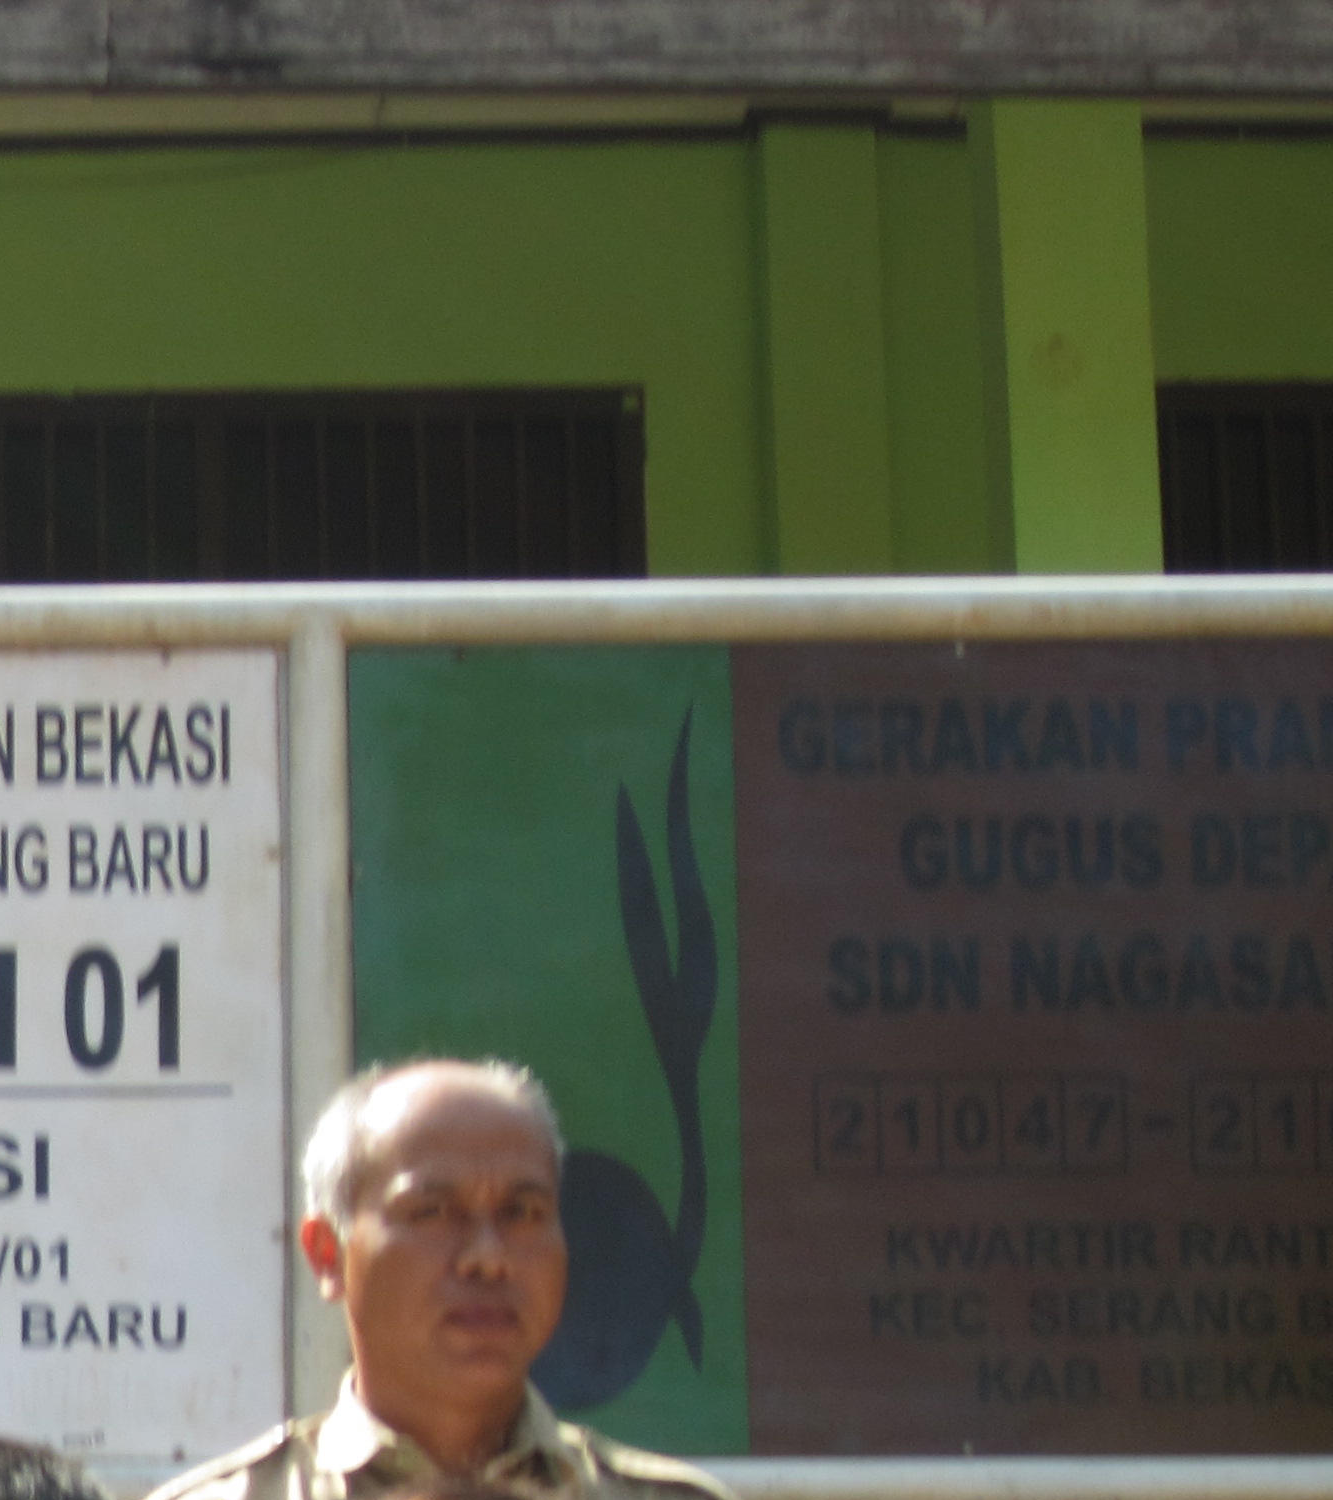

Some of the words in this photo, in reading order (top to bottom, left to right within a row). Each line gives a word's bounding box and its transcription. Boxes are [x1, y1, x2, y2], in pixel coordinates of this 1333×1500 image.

[35, 702, 231, 787] BEKASI
[779, 697, 1139, 776] GERAKAN
[67, 822, 211, 895] BARU
[900, 814, 1165, 892] GUGUS
[63, 941, 181, 1074] 01
[828, 936, 982, 1014] SDN
[1011, 933, 1333, 1014] NAGASA
[886, 1222, 1159, 1269] KWARTIR
[20, 1302, 188, 1349] BARU
[1026, 1288, 1277, 1338] SERANG
